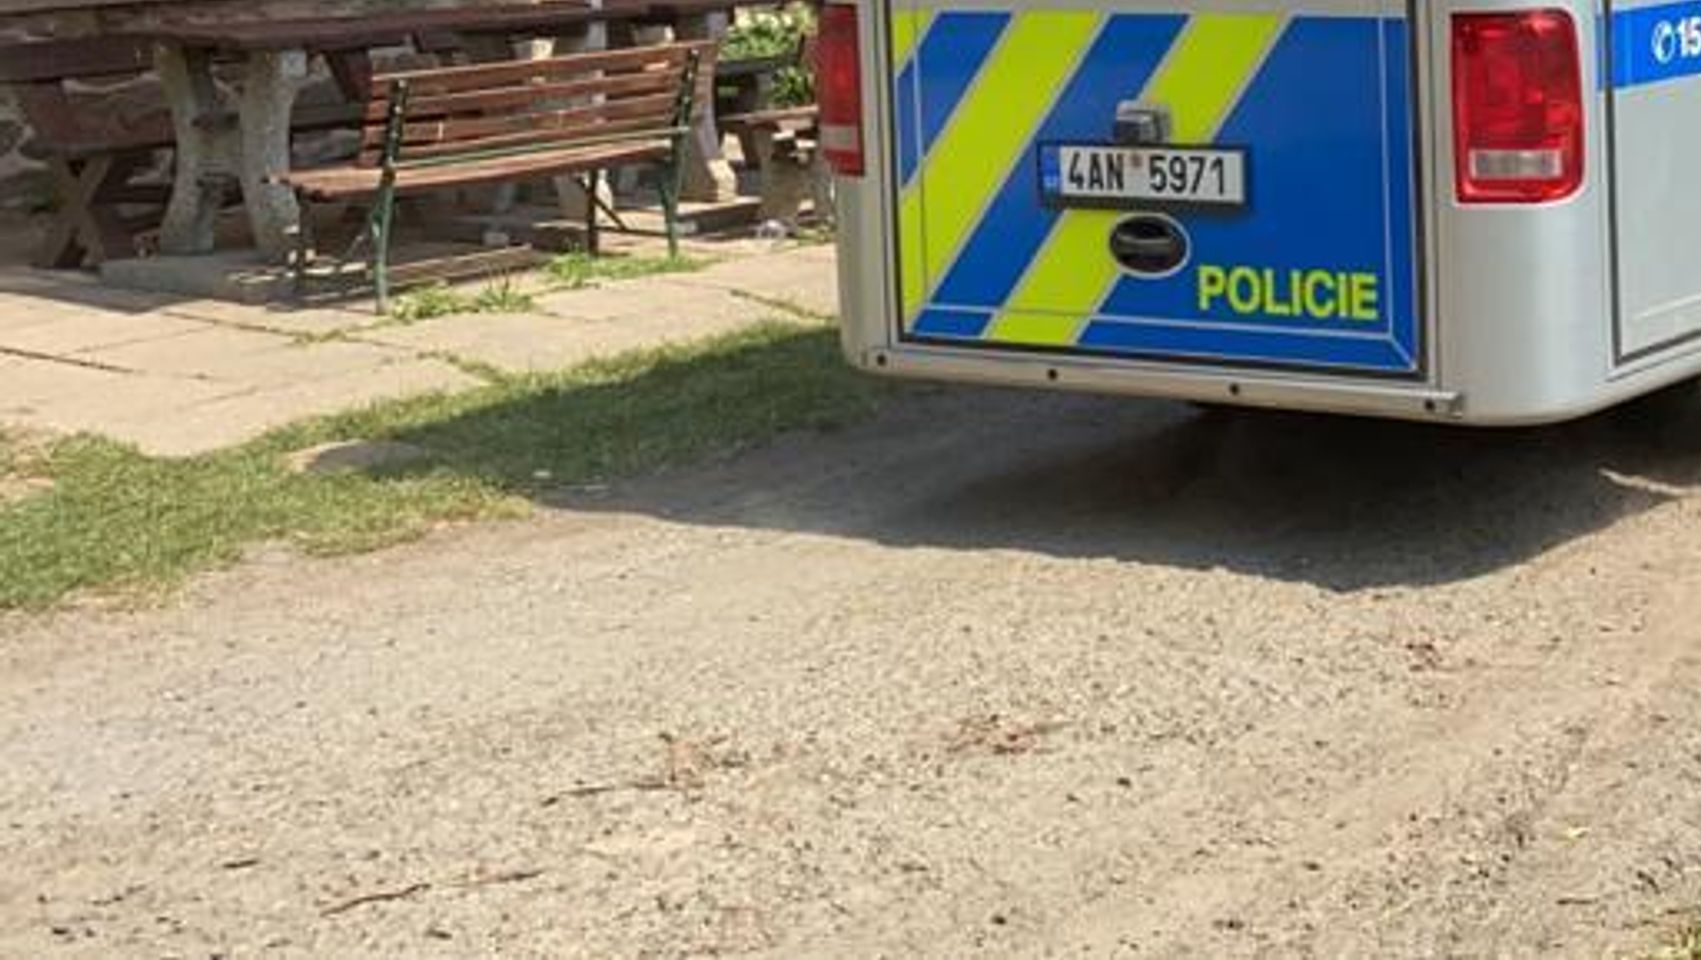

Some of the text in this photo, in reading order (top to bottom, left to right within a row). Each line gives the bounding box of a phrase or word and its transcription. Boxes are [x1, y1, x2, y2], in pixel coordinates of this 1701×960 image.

[1069, 152, 1225, 195] 4AN 5971
[1198, 265, 1378, 321] POLICIE
